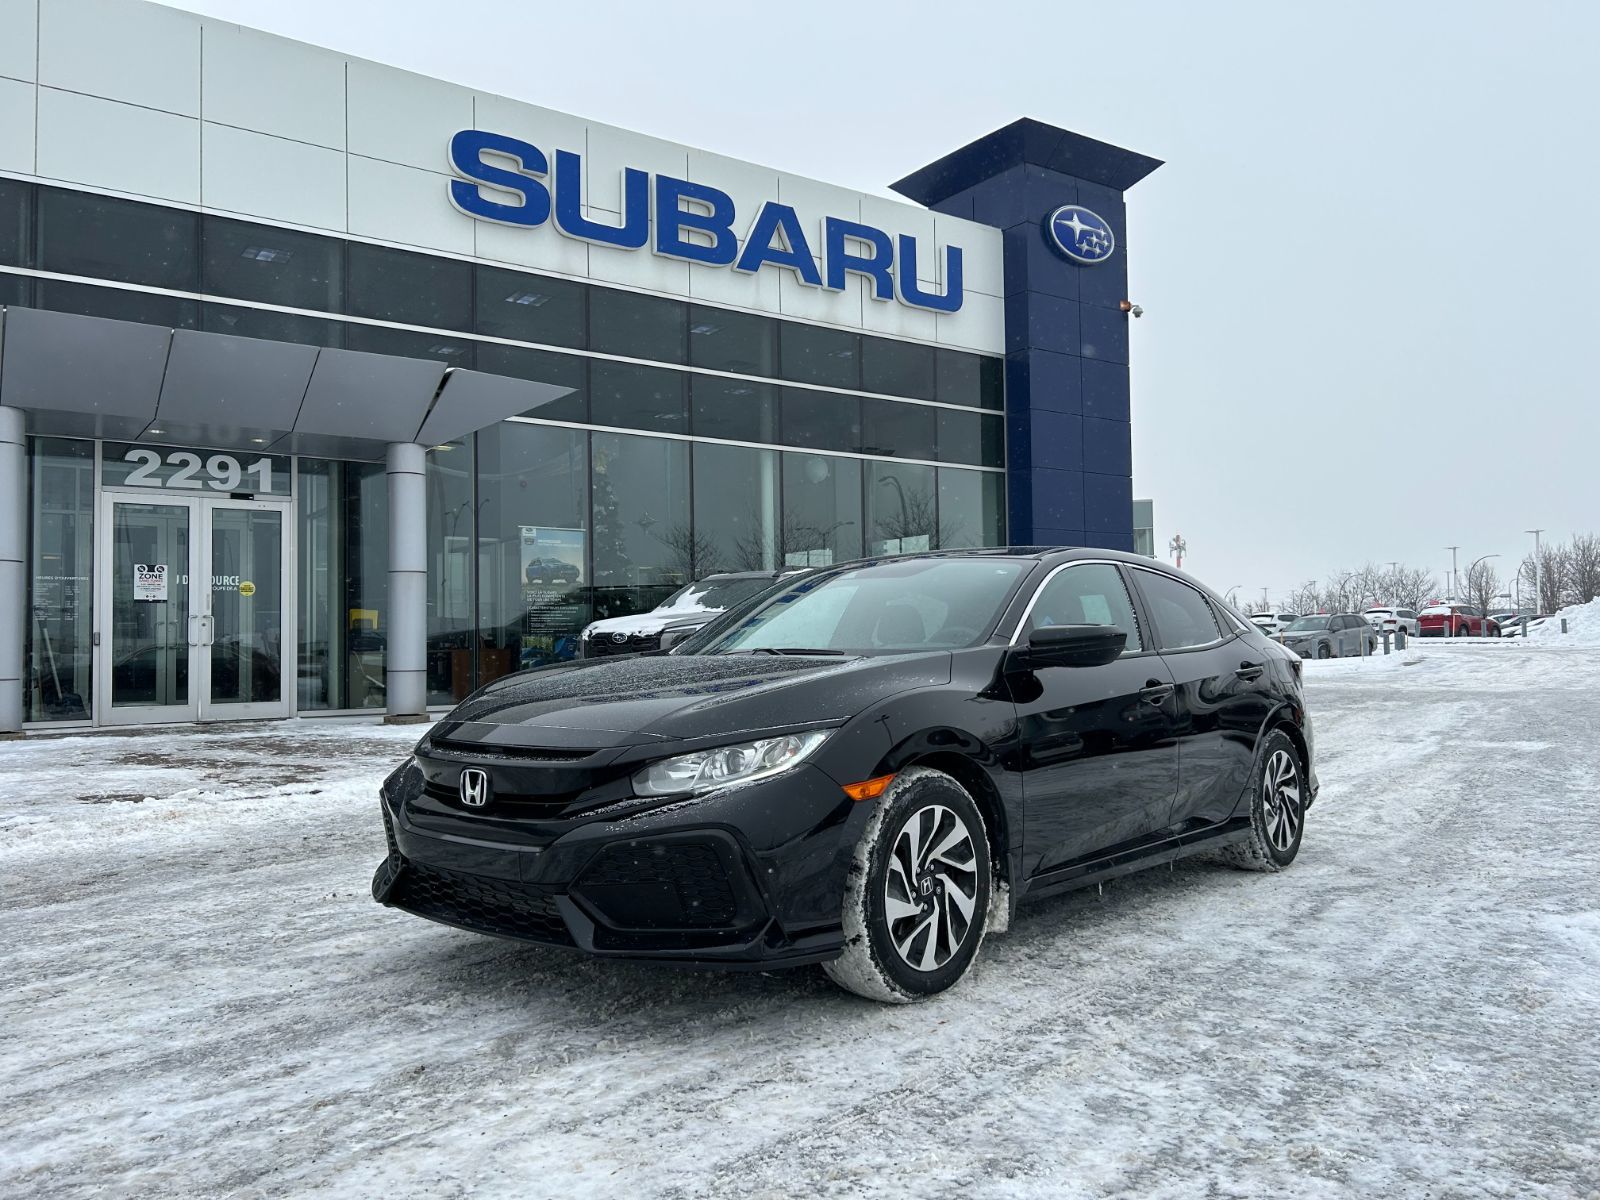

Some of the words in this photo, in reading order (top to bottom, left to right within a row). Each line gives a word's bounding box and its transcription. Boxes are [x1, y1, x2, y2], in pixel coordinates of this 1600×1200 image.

[448, 129, 963, 315] SUBARU
[124, 449, 272, 493] 2291
[211, 575, 239, 586] OURCE
